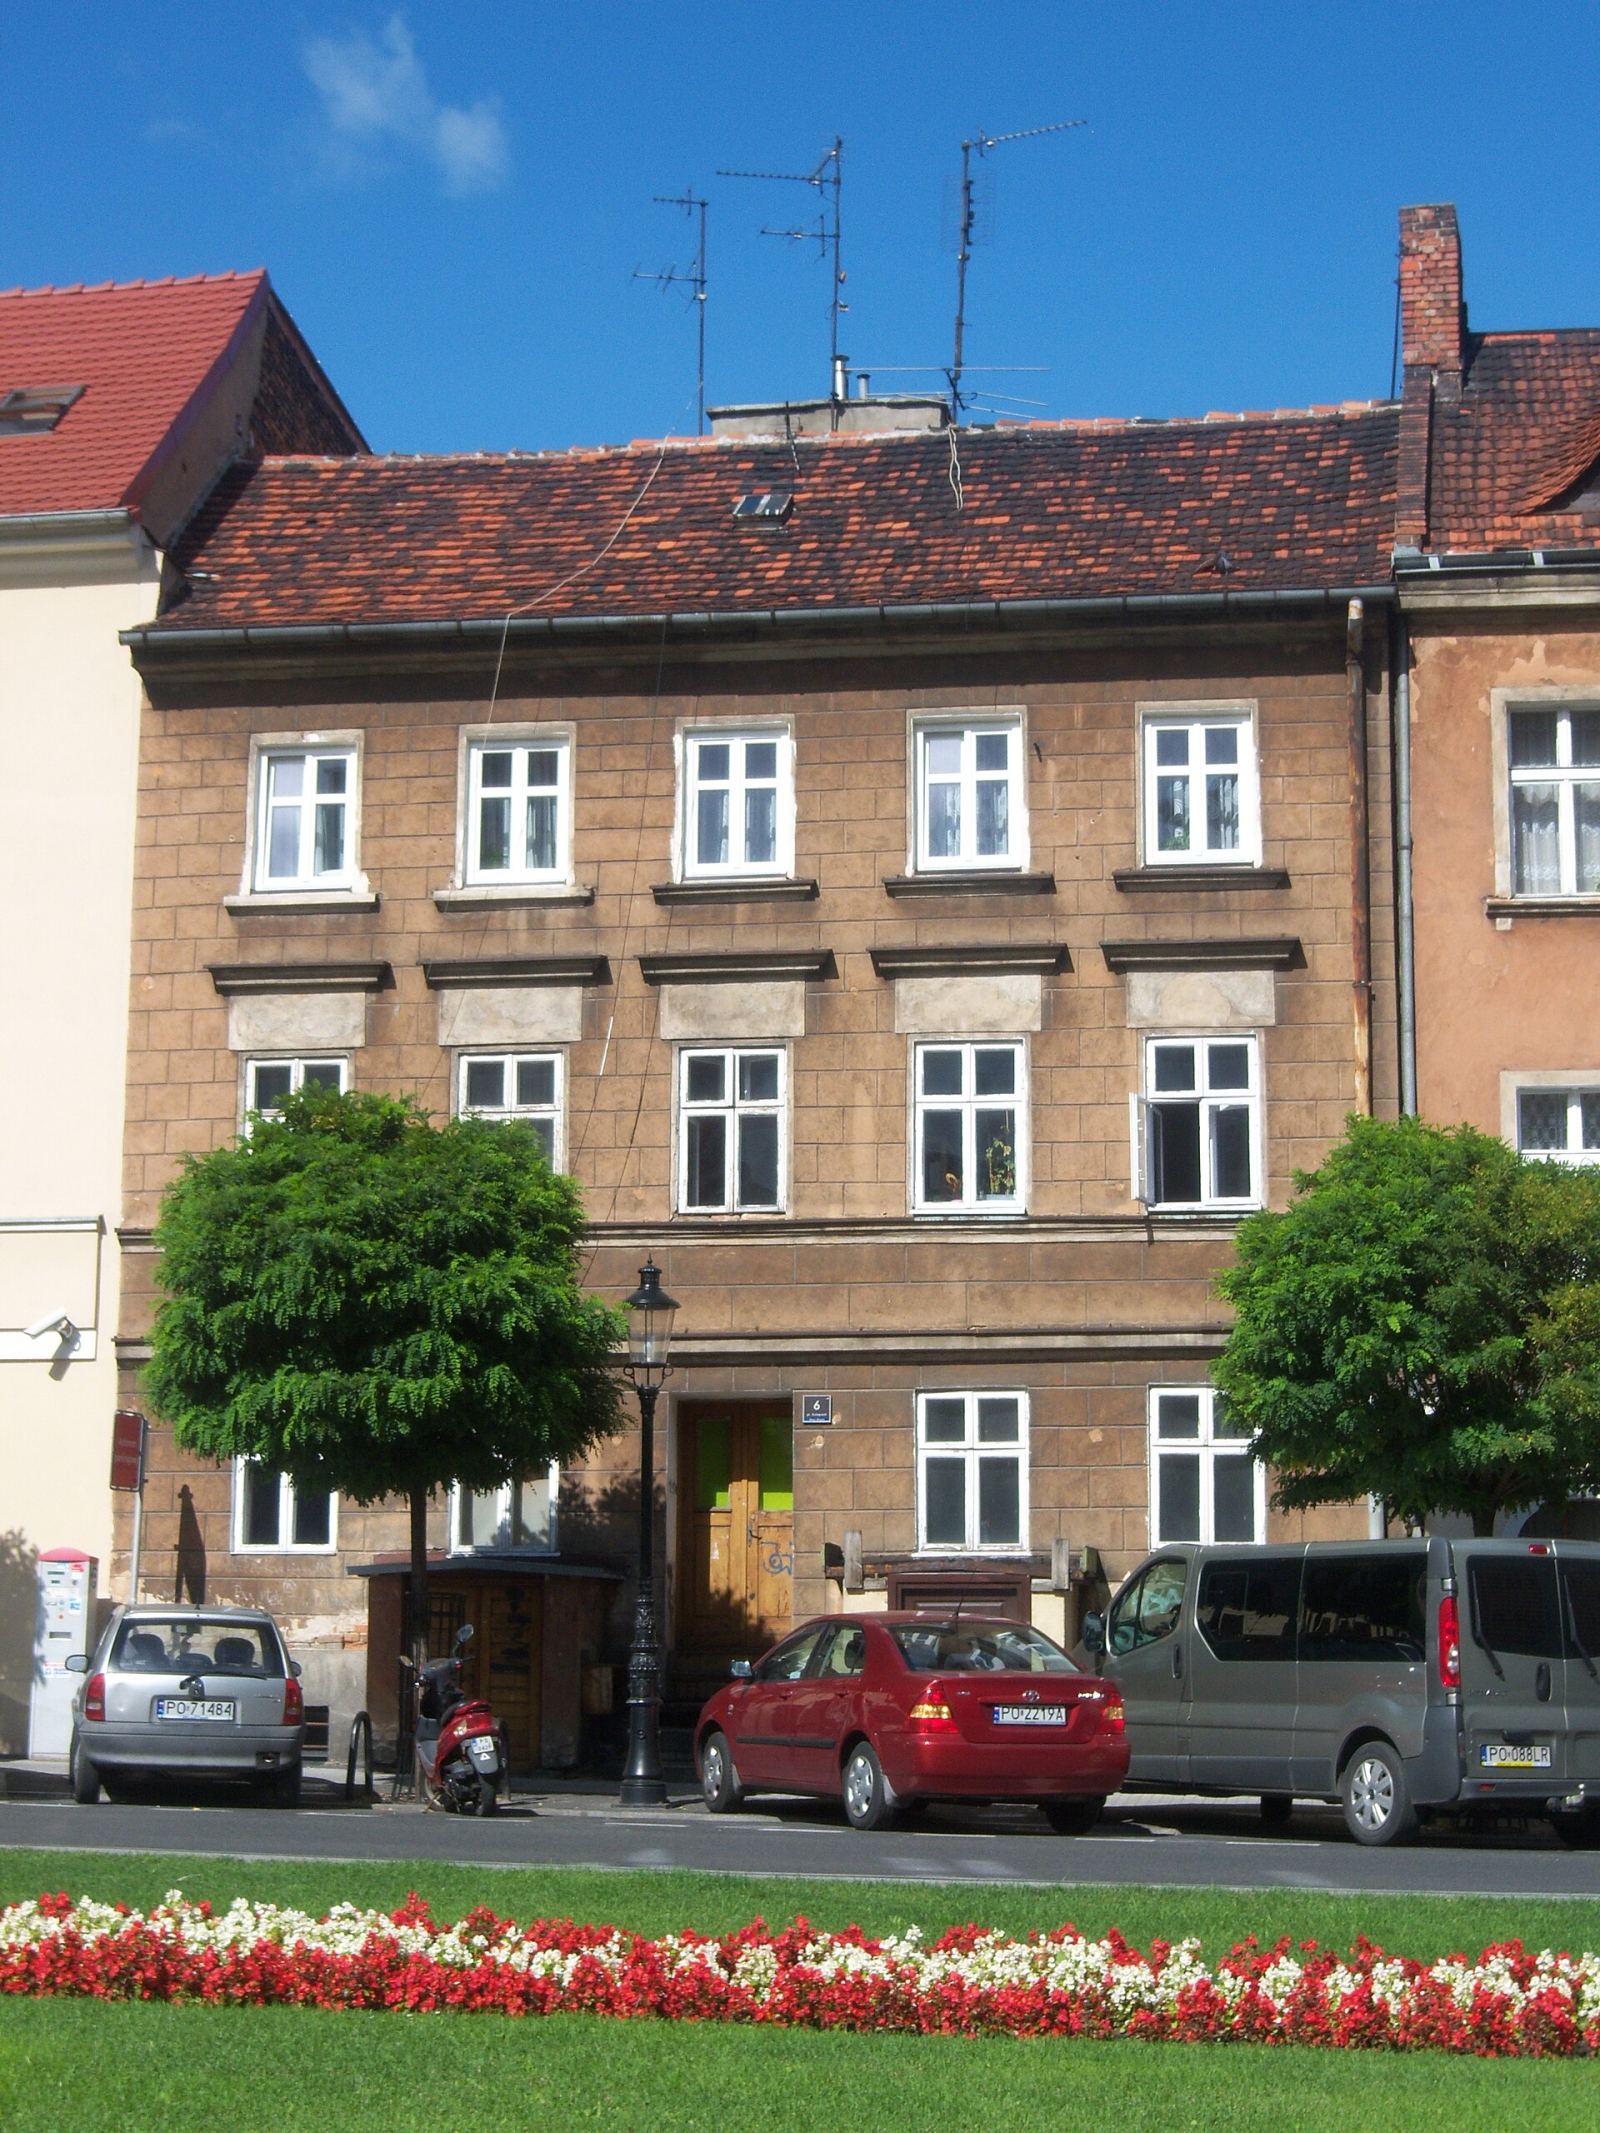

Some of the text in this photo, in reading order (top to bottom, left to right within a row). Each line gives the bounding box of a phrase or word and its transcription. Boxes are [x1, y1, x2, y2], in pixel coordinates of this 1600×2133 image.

[813, 1399, 821, 1410] 6
[166, 1701, 231, 1716] PO 71484
[1001, 1706, 1063, 1721] PO 2219A
[1489, 1747, 1548, 1762] PO 088LR
